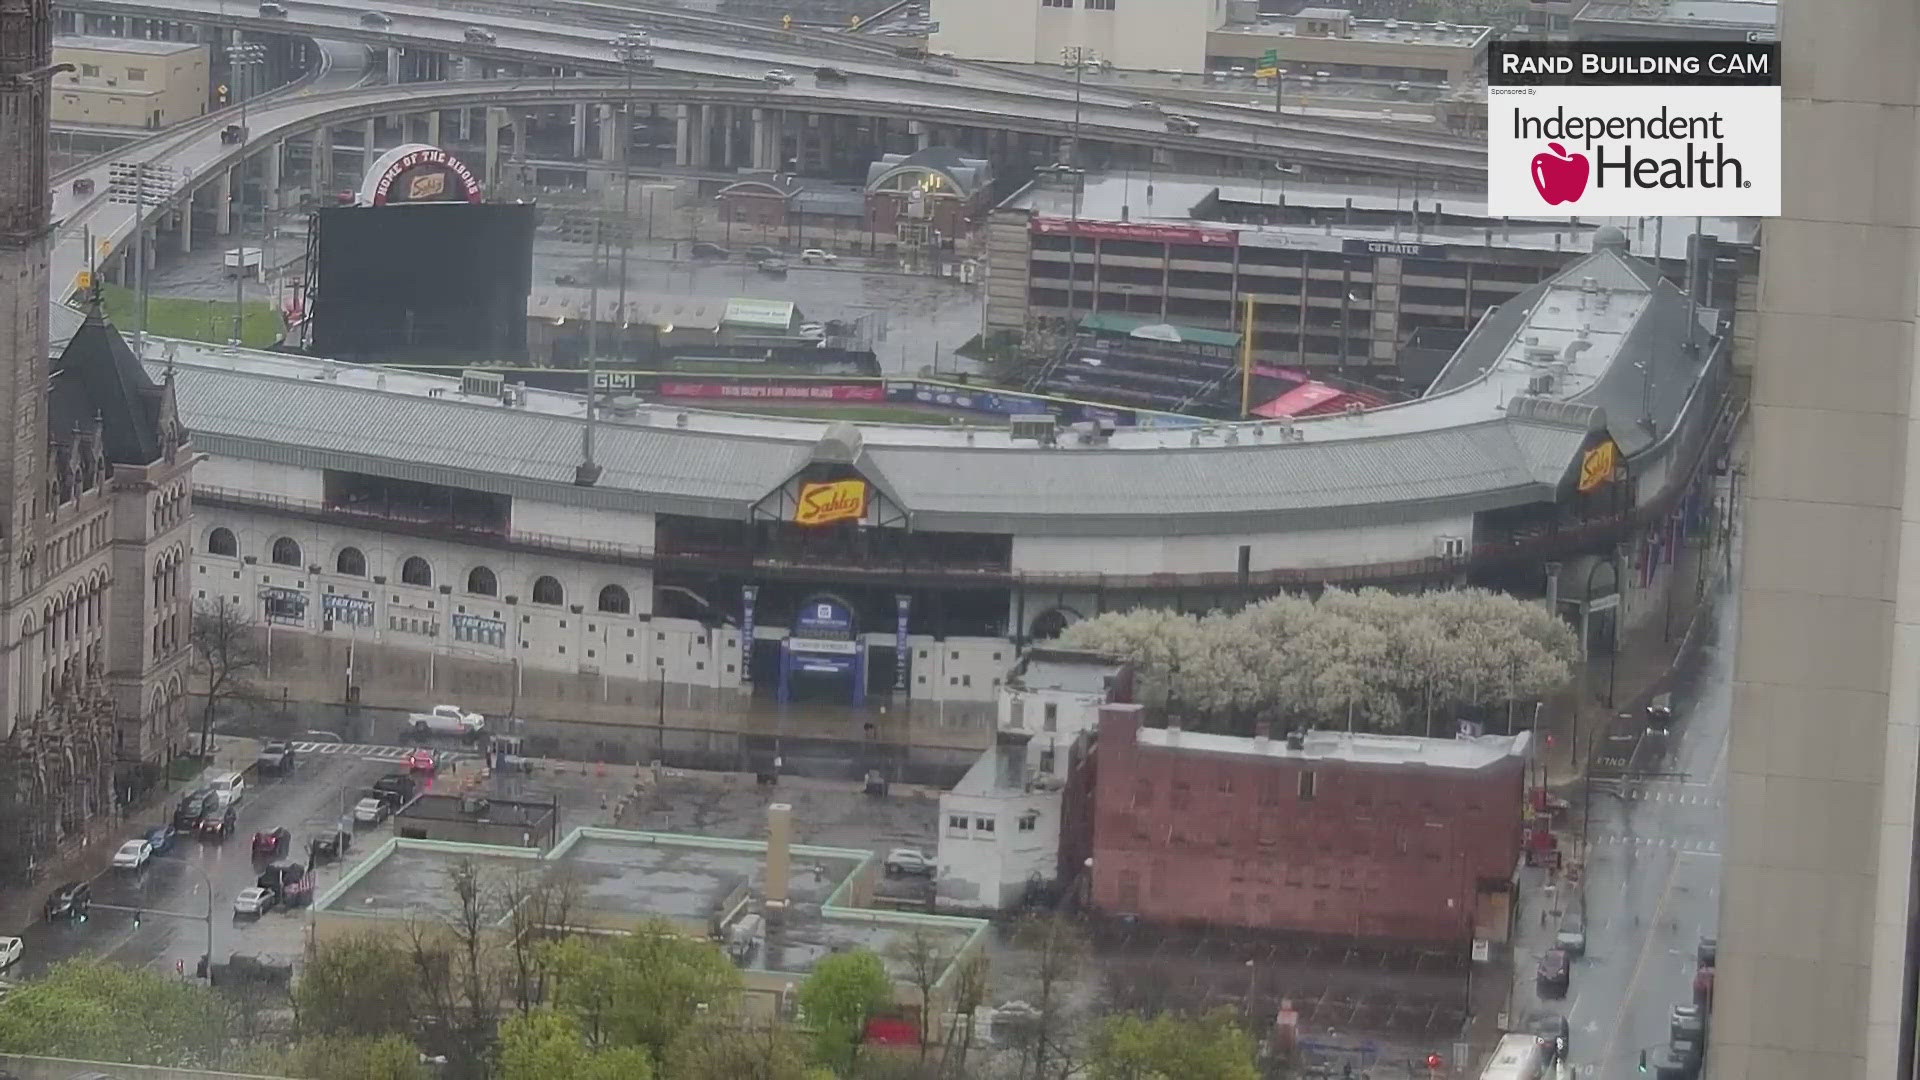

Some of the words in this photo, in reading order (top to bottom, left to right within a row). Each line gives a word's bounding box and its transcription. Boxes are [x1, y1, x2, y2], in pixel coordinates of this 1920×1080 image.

[378, 164, 402, 196] HOME
[404, 154, 417, 167] OF
[422, 151, 446, 163] THE
[1368, 243, 1419, 255] CUTWATER
[594, 373, 636, 389] GLMI
